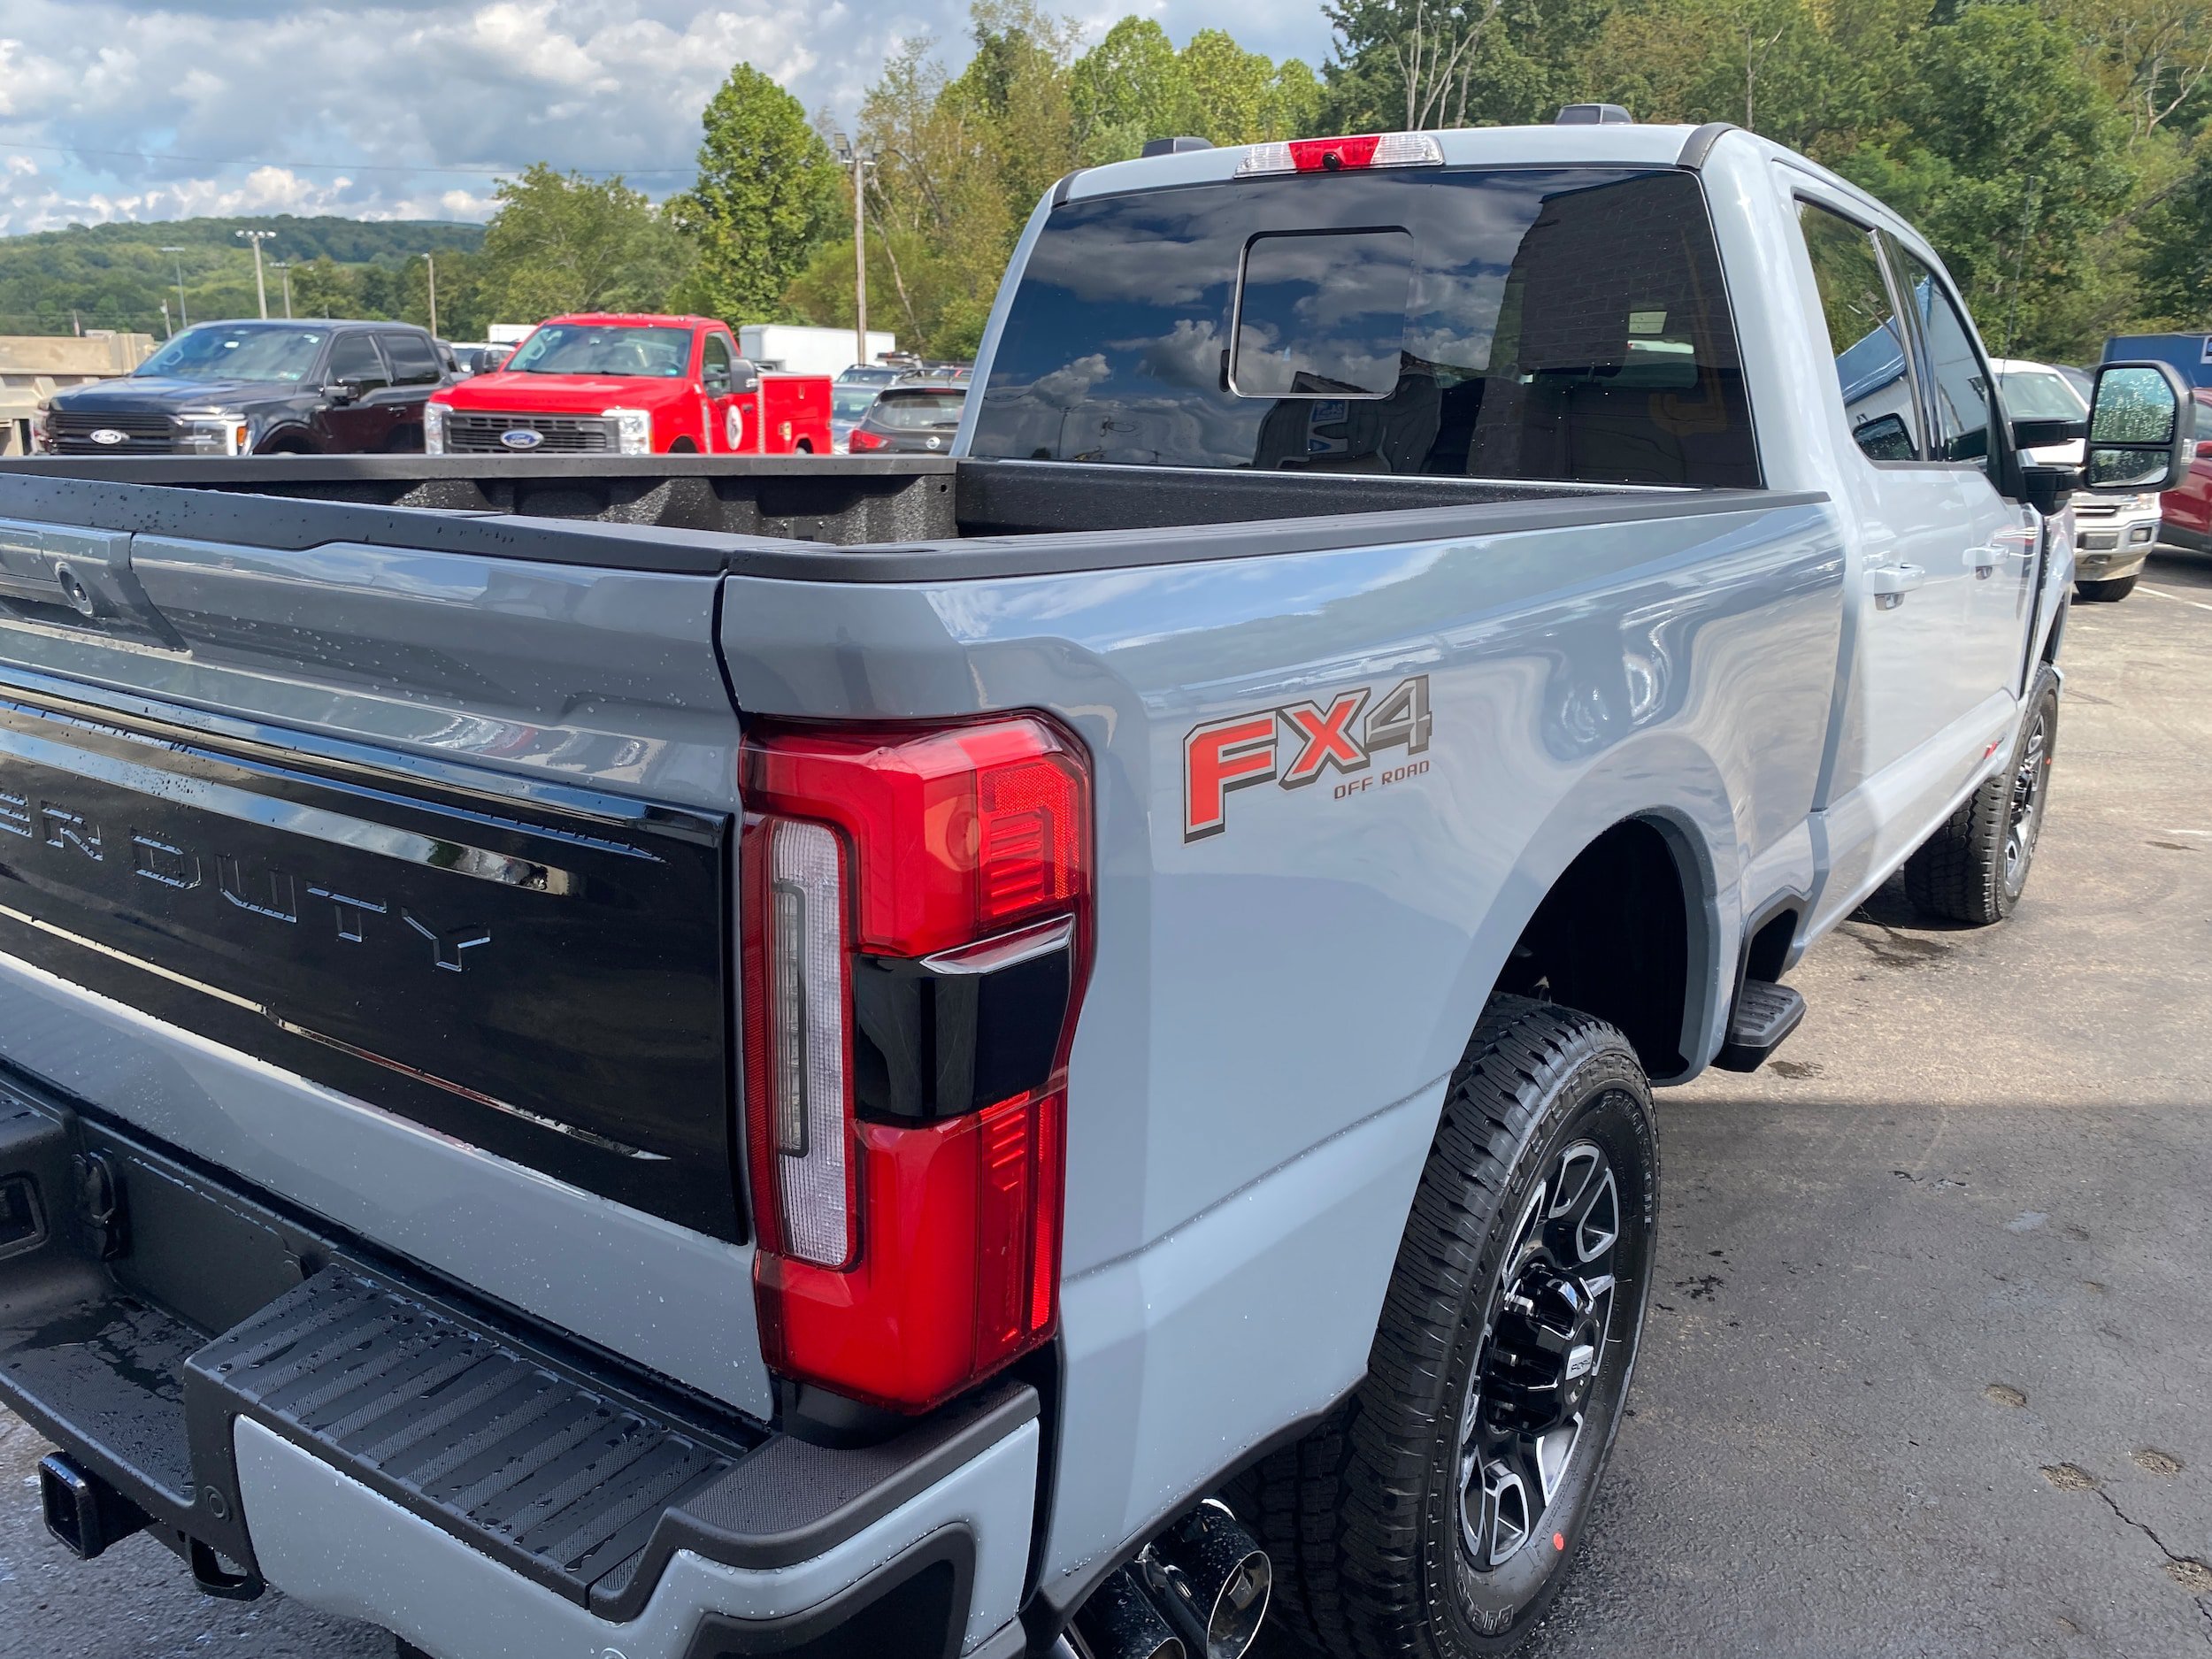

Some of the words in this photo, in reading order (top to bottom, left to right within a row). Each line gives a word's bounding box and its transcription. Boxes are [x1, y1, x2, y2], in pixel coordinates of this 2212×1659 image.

[1183, 674, 1432, 844] FX4
[1334, 776, 1373, 799] OFF
[1382, 760, 1430, 786] ROAD
[131, 825, 490, 972] DUTY
